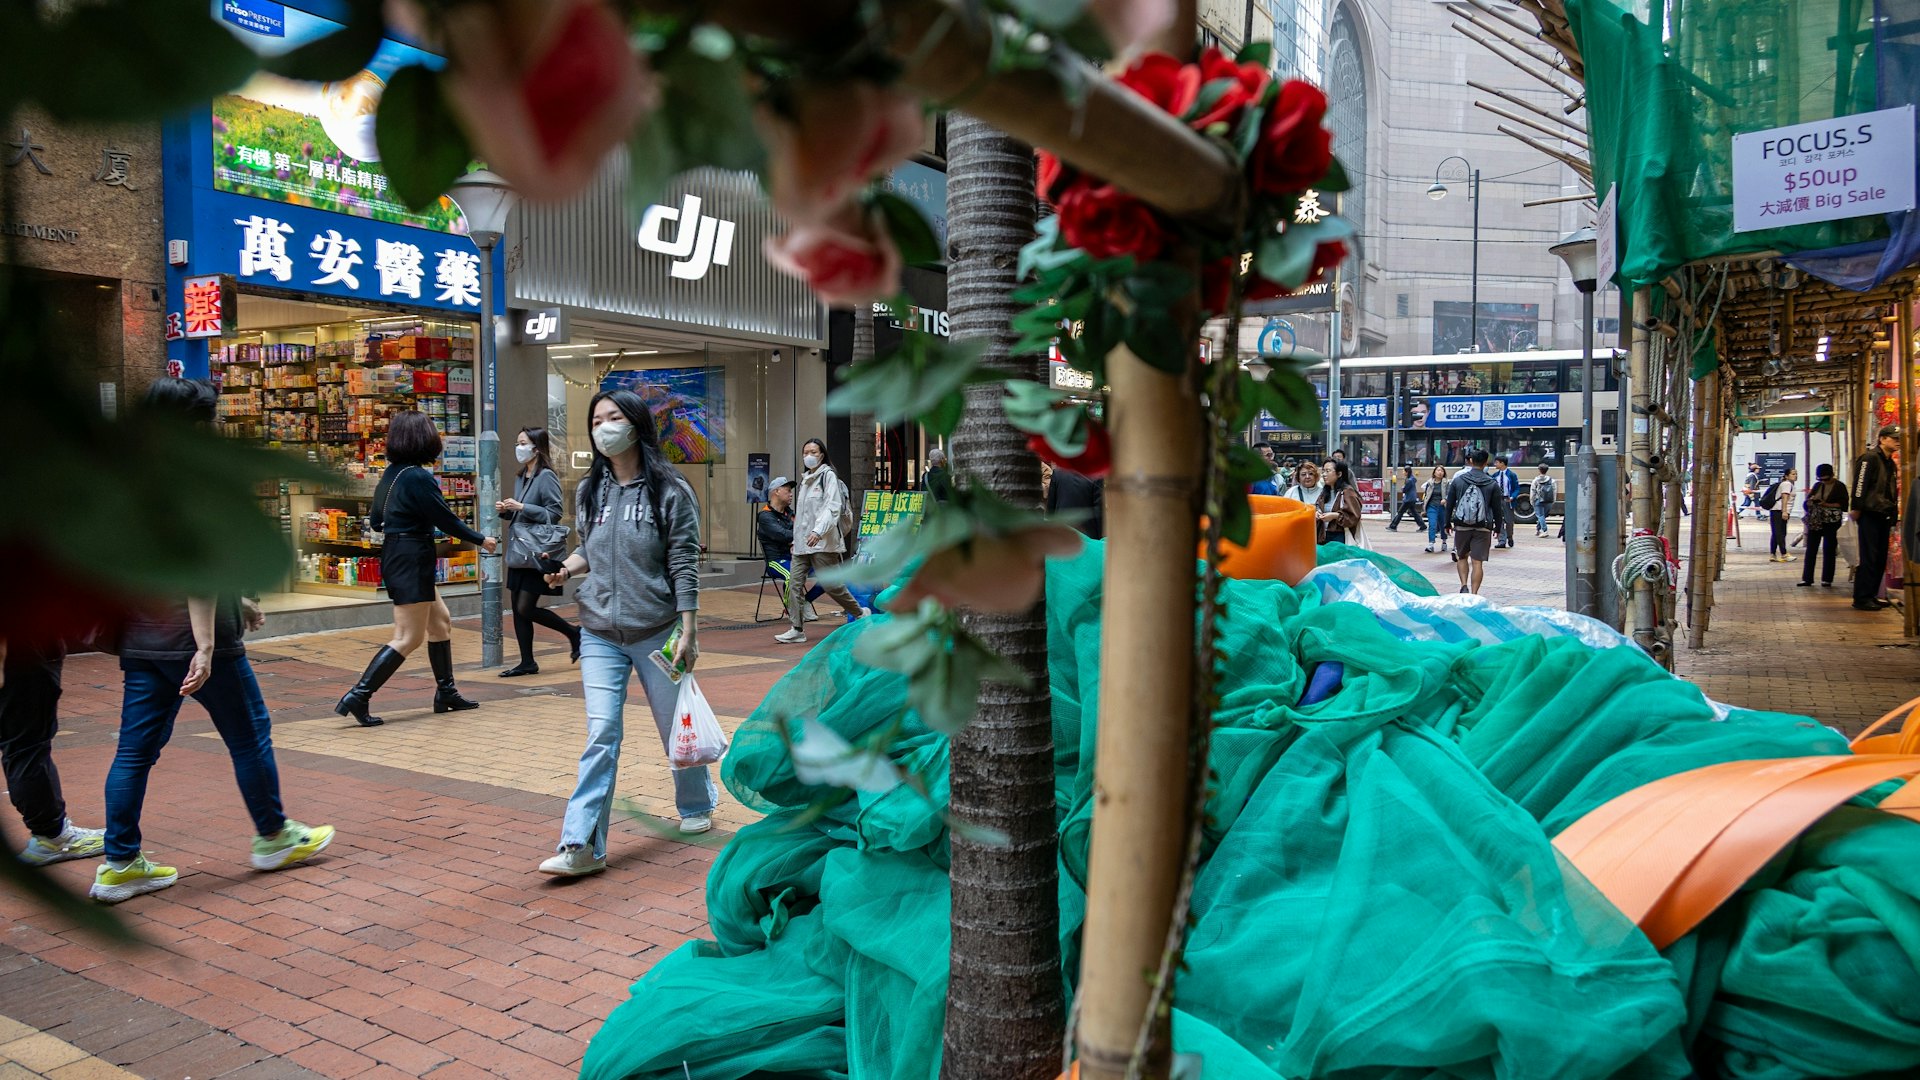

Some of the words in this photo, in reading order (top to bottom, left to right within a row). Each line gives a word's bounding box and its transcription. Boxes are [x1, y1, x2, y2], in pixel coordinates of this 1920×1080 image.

[1763, 124, 1872, 160] FOCUS.S
[236, 145, 272, 168] 有機
[273, 151, 388, 192] 第一層乳脂精華
[1784, 167, 1857, 193] $50up
[1760, 196, 1811, 217] 大減價
[1815, 192, 1842, 209] Big
[1848, 186, 1886, 204] Sale
[233, 215, 482, 307] 萬安醫藥
[1442, 403, 1472, 413] 1192.7
